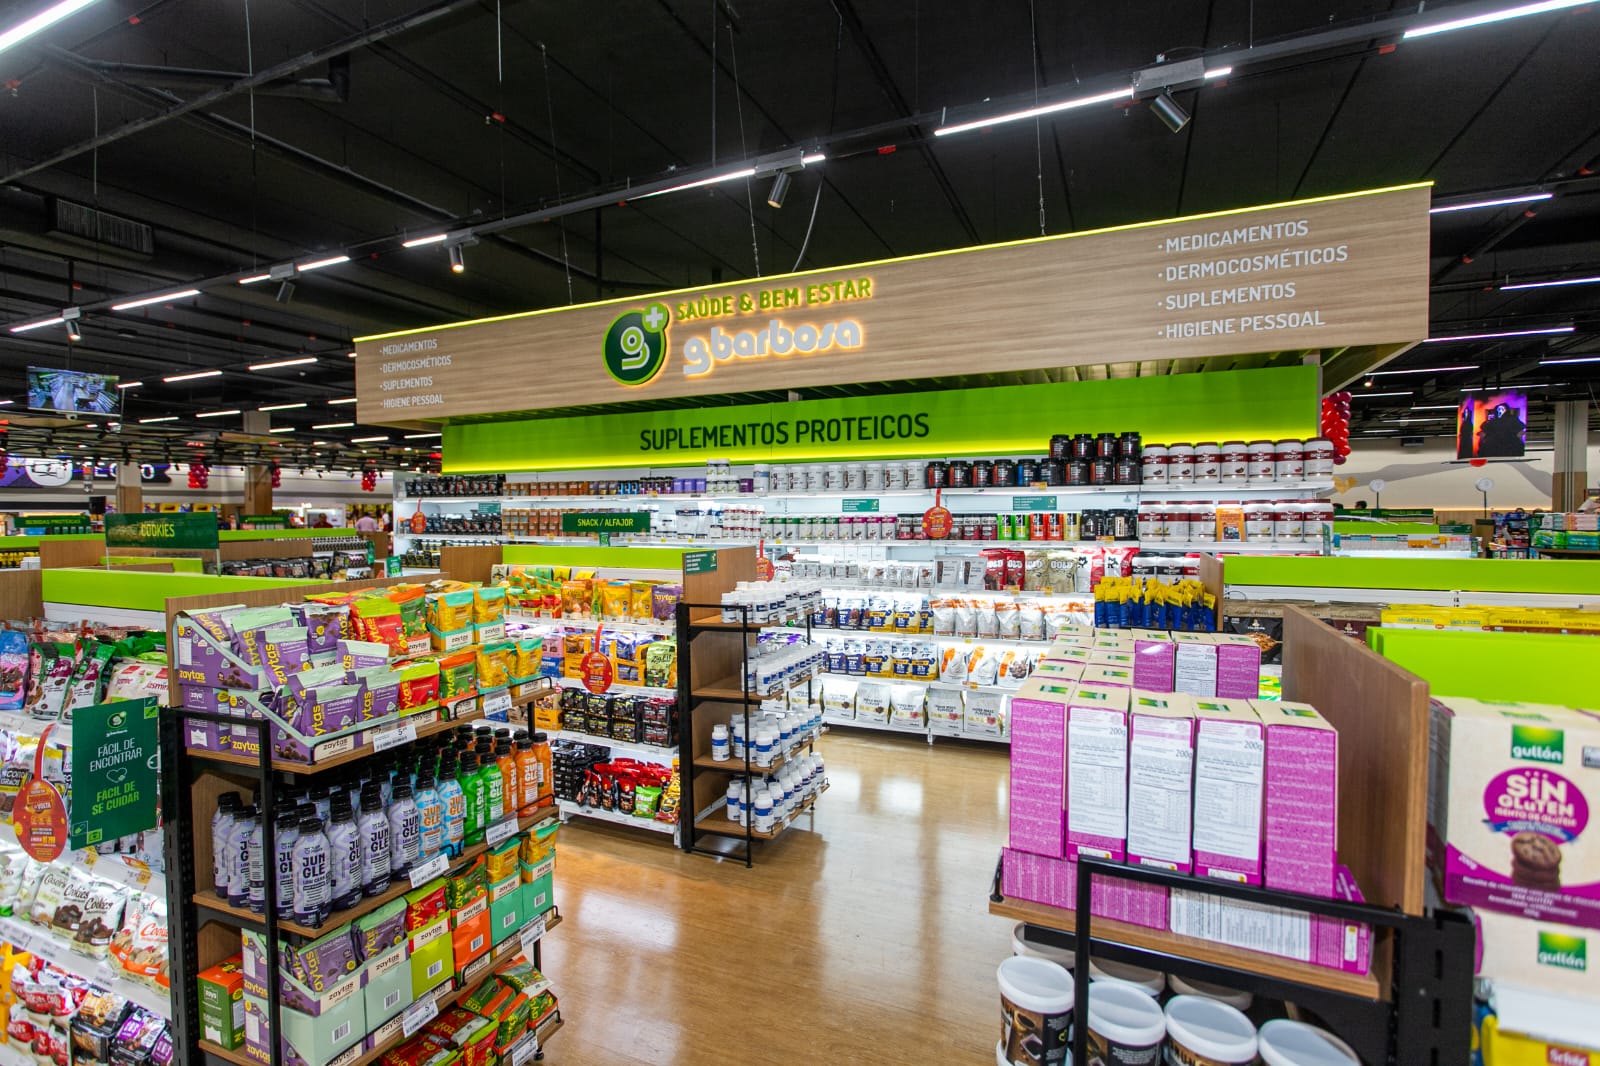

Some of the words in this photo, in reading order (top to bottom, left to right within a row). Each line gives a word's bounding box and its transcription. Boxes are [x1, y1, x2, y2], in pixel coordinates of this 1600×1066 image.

[1166, 220, 1309, 252] MEDICAMENTOS
[1166, 245, 1348, 281] DERMOCOSMÉTICOS
[675, 294, 734, 321] SAÚDE
[739, 293, 754, 312] &
[758, 287, 799, 310] BEM
[806, 278, 872, 304] ESTAR
[1165, 282, 1297, 311] SUPLEMENTOS
[1166, 317, 1236, 339] HIGIENE
[1240, 310, 1326, 333] PESSOAL
[382, 339, 438, 355] MEDICAMENTOS
[683, 319, 862, 375] gbarbosa
[382, 355, 452, 374] DERMOCOSMÉTICOS
[382, 376, 433, 391] SUPLEMENTOS
[383, 397, 411, 409] HIGIENE
[411, 394, 445, 406] PESSOAL
[640, 420, 789, 451] SUPLEMENTOS
[795, 412, 930, 443] PROTEICOS
[140, 523, 175, 538] COOKIES
[577, 518, 599, 527] SNACK
[604, 518, 634, 527] ALFAJOR
[179, 669, 205, 682] zaytas
[144, 680, 168, 690] jasmin
[312, 704, 326, 737] ytas
[123, 737, 136, 750] DE
[232, 740, 260, 753] zaytas
[323, 738, 348, 751] zaytas
[89, 747, 142, 773] ENCONTRAR
[1512, 744, 1562, 762] gullón
[124, 780, 135, 793] DE
[92, 802, 104, 816] SE
[106, 791, 140, 811] CUIDAR
[370, 828, 389, 842] JUN
[370, 838, 389, 852] GLE
[303, 852, 325, 868] JUN
[303, 863, 325, 879] GLE
[84, 897, 114, 911] Cookies
[463, 903, 482, 917] zaytas
[420, 926, 443, 940] zaytas
[375, 953, 400, 971] zaytas
[1538, 951, 1585, 970] gullón
[306, 951, 323, 992] aytas
[329, 981, 354, 1001] zaytas
